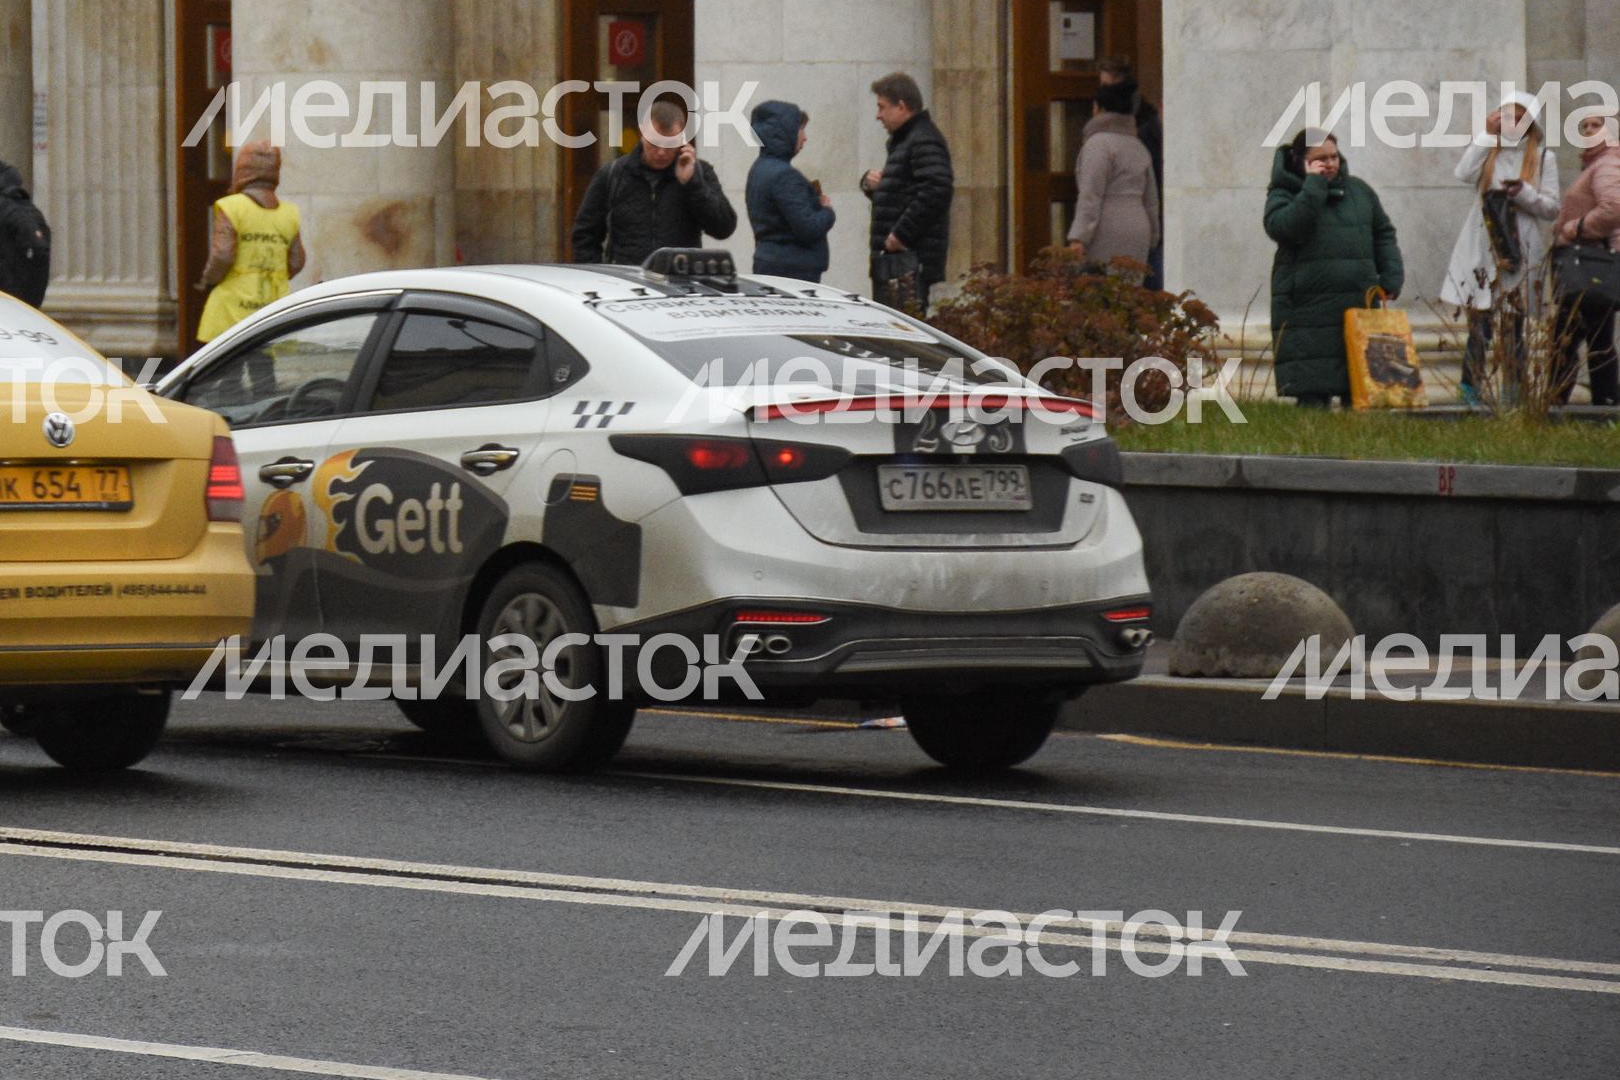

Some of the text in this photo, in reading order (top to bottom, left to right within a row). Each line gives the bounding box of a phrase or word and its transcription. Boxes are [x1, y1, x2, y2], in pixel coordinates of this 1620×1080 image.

[31, 471, 81, 499] 654
[96, 469, 120, 492] 77
[888, 470, 1021, 500] С766АЕ 799
[355, 482, 463, 554] Gett
[25, 582, 114, 600] ВОДИТЕЛЕЙ
